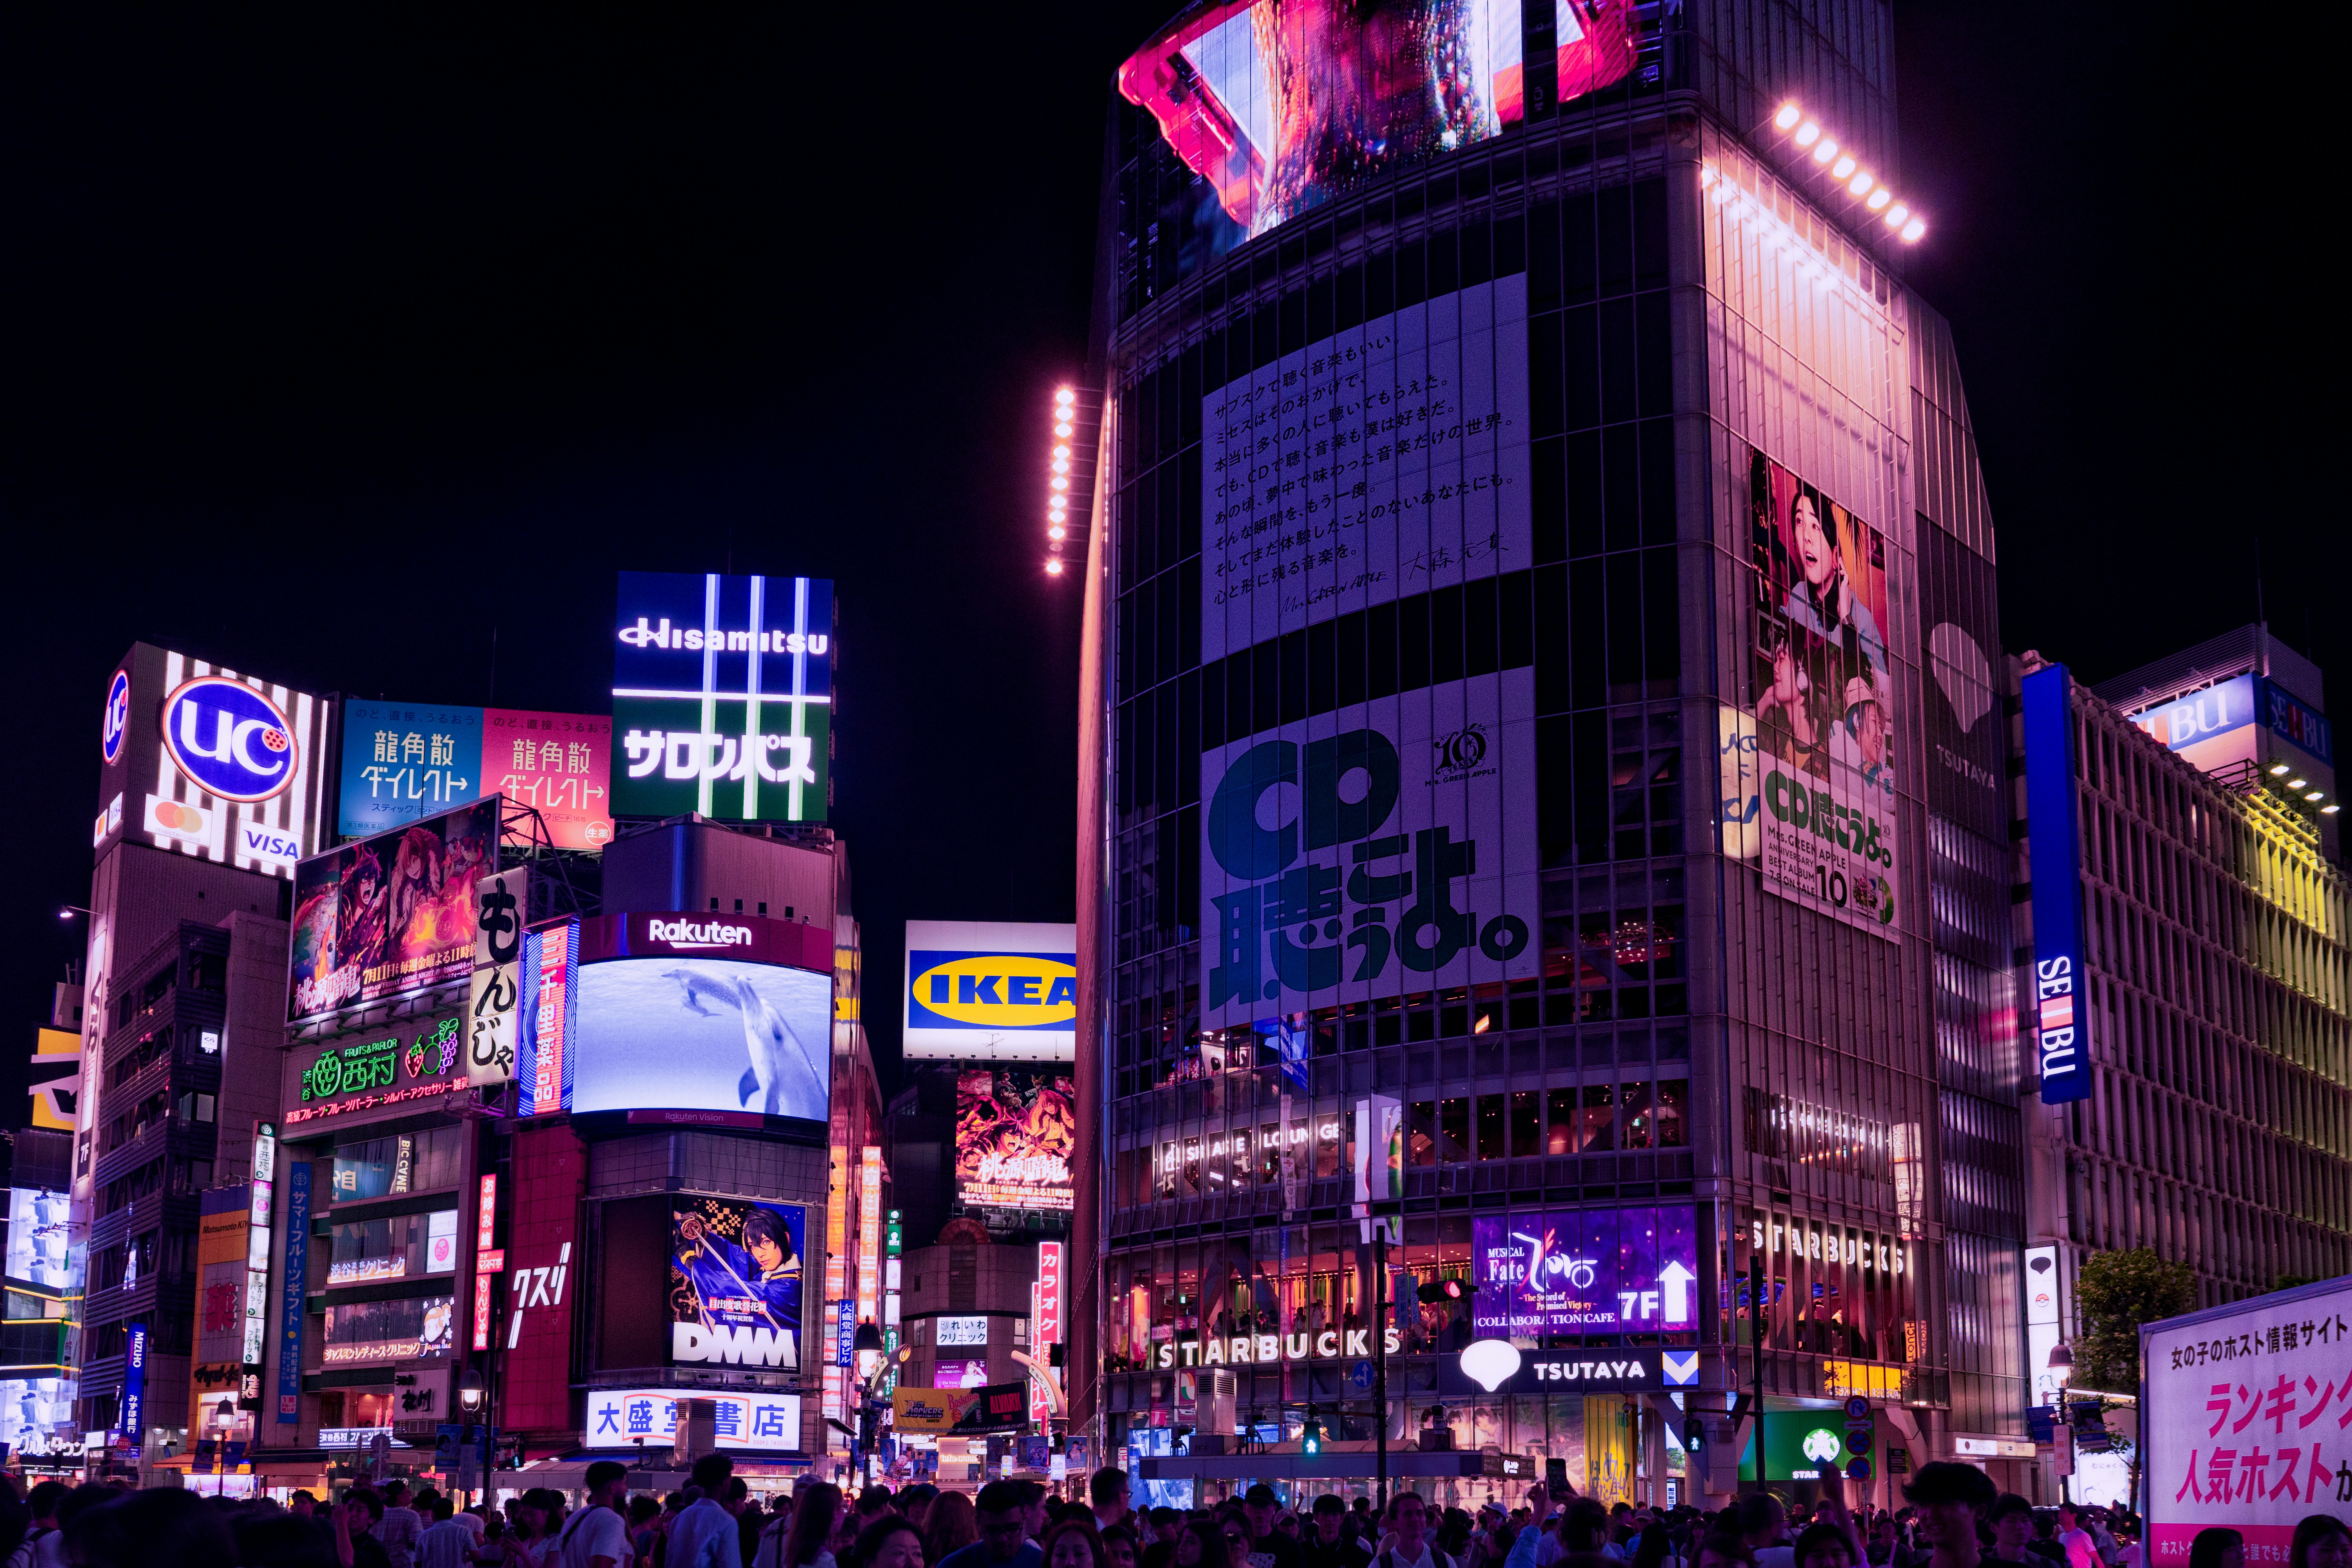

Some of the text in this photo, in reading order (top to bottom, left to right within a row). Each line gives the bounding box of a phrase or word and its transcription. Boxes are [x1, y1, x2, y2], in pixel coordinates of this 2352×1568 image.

[1215, 336, 1399, 419] サブスクで聴く音楽もいい。
[1214, 374, 1448, 473] 本当に多くの人に聴いてもらえた。
[1216, 372, 1366, 445] ミセスはそのおかげで、
[1215, 403, 1454, 498] でも、CDで聴く音楽も僕は好きだ。
[1215, 412, 1512, 525] あの頃、夢中で味わった音楽だけの世界。
[1214, 482, 1376, 550] そんな瞬間を、もう一度。
[1214, 474, 1513, 577] そしてまだ体験したことのないあなたにも。
[1214, 544, 1357, 605] 心と形に残る音楽を。
[1349, 570, 1388, 592] APPLE
[619, 618, 828, 654] Hisamitsu
[2271, 691, 2327, 758] SEIBU
[374, 730, 454, 766] 龍角散
[513, 739, 591, 774] 龍角散
[625, 730, 815, 783] サロンパス
[1434, 731, 1486, 775] 10
[361, 766, 468, 801] ダイレクト
[1443, 773, 1470, 783] GREEN
[1471, 768, 1497, 778] APPLE
[1936, 744, 1996, 792] TSUTAYA
[372, 803, 413, 813] スティック
[499, 774, 604, 809] ダイレクト
[111, 802, 121, 821] VISA
[156, 828, 200, 843] mastercard
[243, 829, 299, 859] VISA
[588, 828, 609, 839] 生薬
[1768, 842, 1814, 868] ANNIVERSARY
[1769, 855, 1815, 883] BEST ALBUM
[1788, 835, 1815, 855] GREEN
[1819, 848, 1846, 869] APPLE
[1783, 875, 1795, 887] ON
[1797, 881, 1815, 897] SALE
[1817, 864, 1847, 908] 10
[650, 918, 752, 946] Rakuten
[472, 878, 521, 1076] もんじゃ
[931, 974, 1076, 1006] IKEA
[534, 935, 560, 1102] 三千里薬品
[2037, 955, 2076, 1081] SEIBU
[301, 1071, 311, 1101] 渋谷
[343, 1052, 396, 1093] 西村
[665, 1112, 724, 1122] Rakuten Vision
[80, 1143, 89, 1163] 7F
[976, 1152, 1069, 1186] 桃源暗鬼
[203, 1224, 237, 1234] Matsumoto
[480, 1178, 494, 1246] お好み焼
[287, 1191, 306, 1326] サマーフルーツギフト
[1488, 1247, 1525, 1258] MUSICAL
[1753, 1221, 1904, 1274] STARBUCKS
[1489, 1259, 1524, 1281] Fate
[205, 1283, 238, 1331] 薬
[508, 1242, 571, 1349] クスリ
[1042, 1254, 1058, 1331] カラオケ
[1524, 1291, 1566, 1302] The Sword of
[1536, 1301, 1592, 1311] Promised Victory
[1618, 1291, 1659, 1320] 7F
[475, 1277, 488, 1347] もんじゃ焼
[951, 1320, 986, 1330] れいわ
[1477, 1312, 1615, 1327] COLLABORATION CAFE
[133, 1332, 144, 1368] MIZUHO
[420, 1342, 452, 1357] Jasmine
[673, 1322, 797, 1367] DMM
[841, 1303, 851, 1364] 大盛堂商事ビル
[940, 1333, 985, 1343] クリニック
[1159, 1328, 1400, 1368] STARBUCKS
[2171, 1314, 2348, 1370] 女の子のホスト情報サイト
[245, 1374, 259, 1399] HUB
[1534, 1360, 1645, 1380] TSUTAYA
[127, 1394, 138, 1434] みずほ銀行
[906, 1400, 944, 1418] ROCKERS
[18, 1435, 85, 1456] グルメタウン
